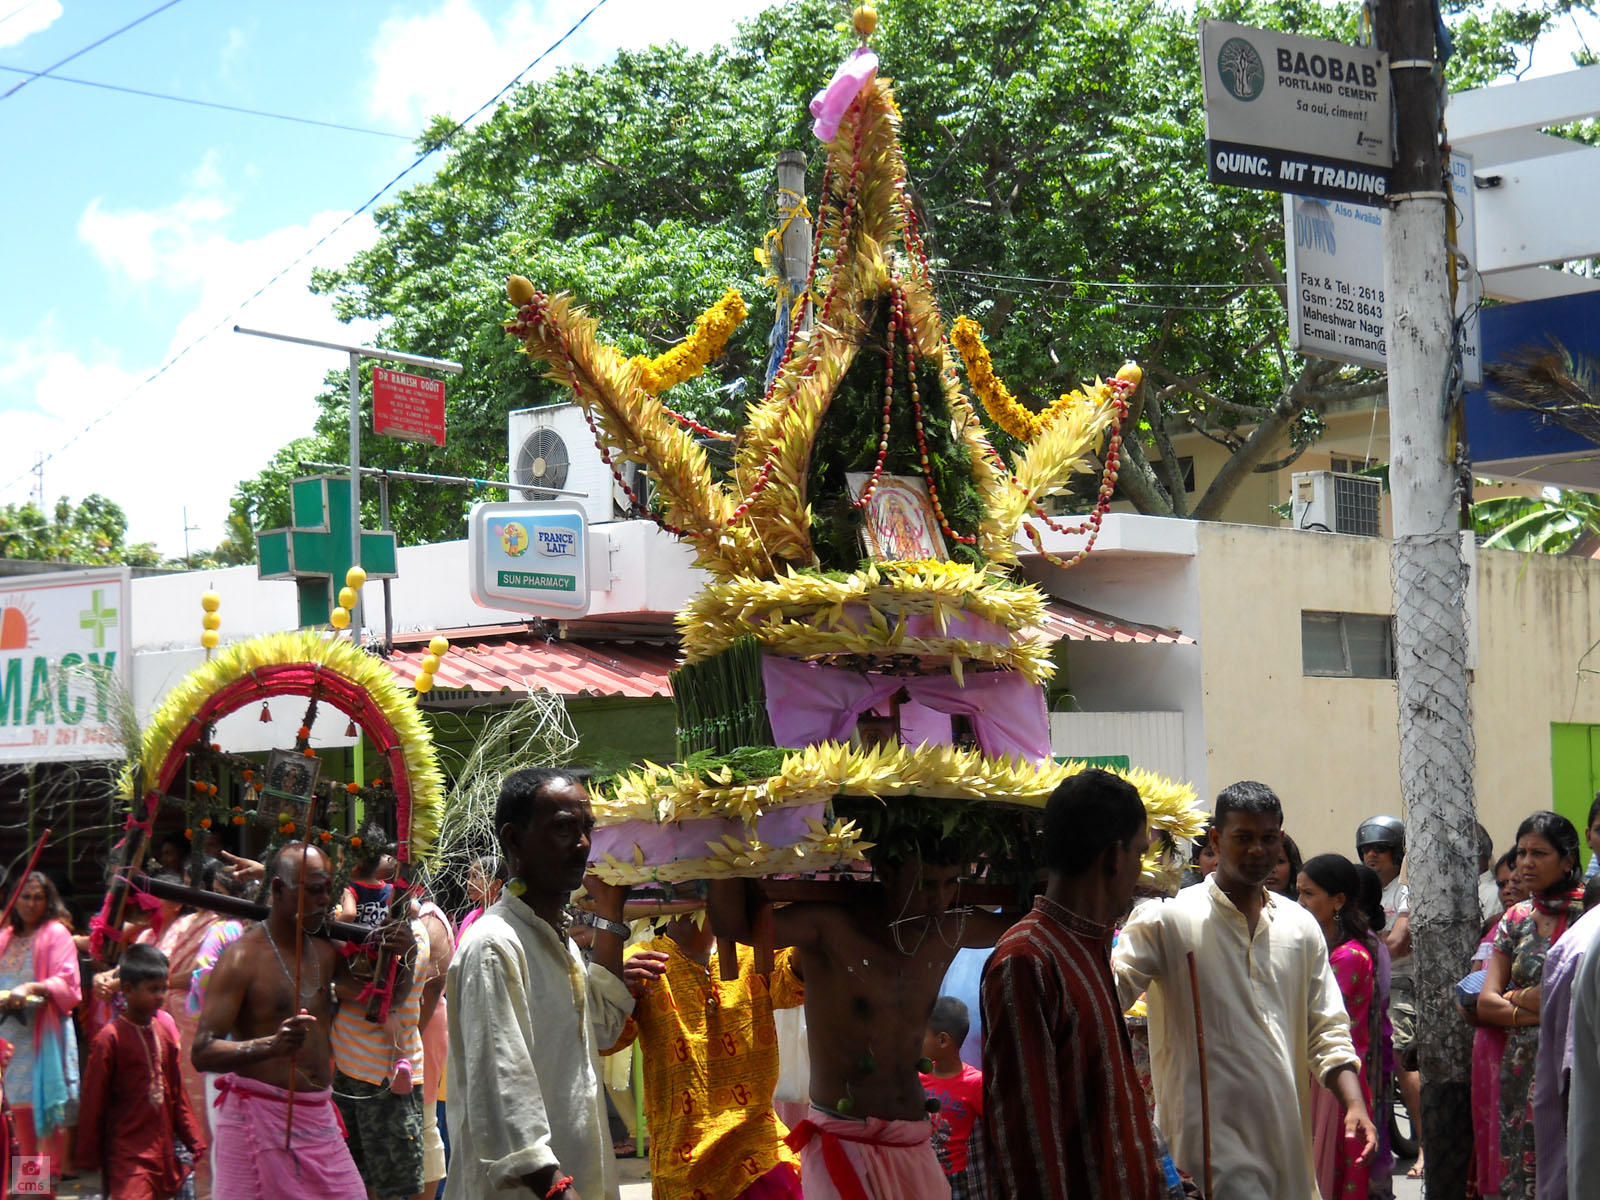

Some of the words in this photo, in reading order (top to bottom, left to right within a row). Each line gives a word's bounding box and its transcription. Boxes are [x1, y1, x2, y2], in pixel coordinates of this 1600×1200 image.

[1277, 47, 1378, 88] BAOBAB
[1278, 75, 1333, 94] PORTLAND
[1338, 86, 1378, 102] CEMENT
[1296, 99, 1309, 112] Sa
[1311, 103, 1329, 117] oui,
[1331, 105, 1368, 122] ciment!
[1216, 151, 1272, 178] QUINC.
[1279, 160, 1308, 183] MT
[1311, 165, 1386, 197] TRADING
[1335, 203, 1353, 219] Also
[1301, 272, 1321, 288] Fax
[1324, 278, 1332, 291] &
[1335, 280, 1350, 296] Tel
[1302, 289, 1327, 306] Gsm
[1335, 297, 1354, 313] 252
[1357, 302, 1383, 319] 8643
[1303, 305, 1357, 330] Maheshwar
[1304, 323, 1336, 343] E-mail
[1344, 335, 1386, 356] raman@
[391, 373, 418, 388] RAMESH
[538, 531, 573, 544] FRANCE
[546, 542, 567, 554] LAIT
[503, 574, 521, 585] SUN
[523, 575, 570, 589] PHARMACY
